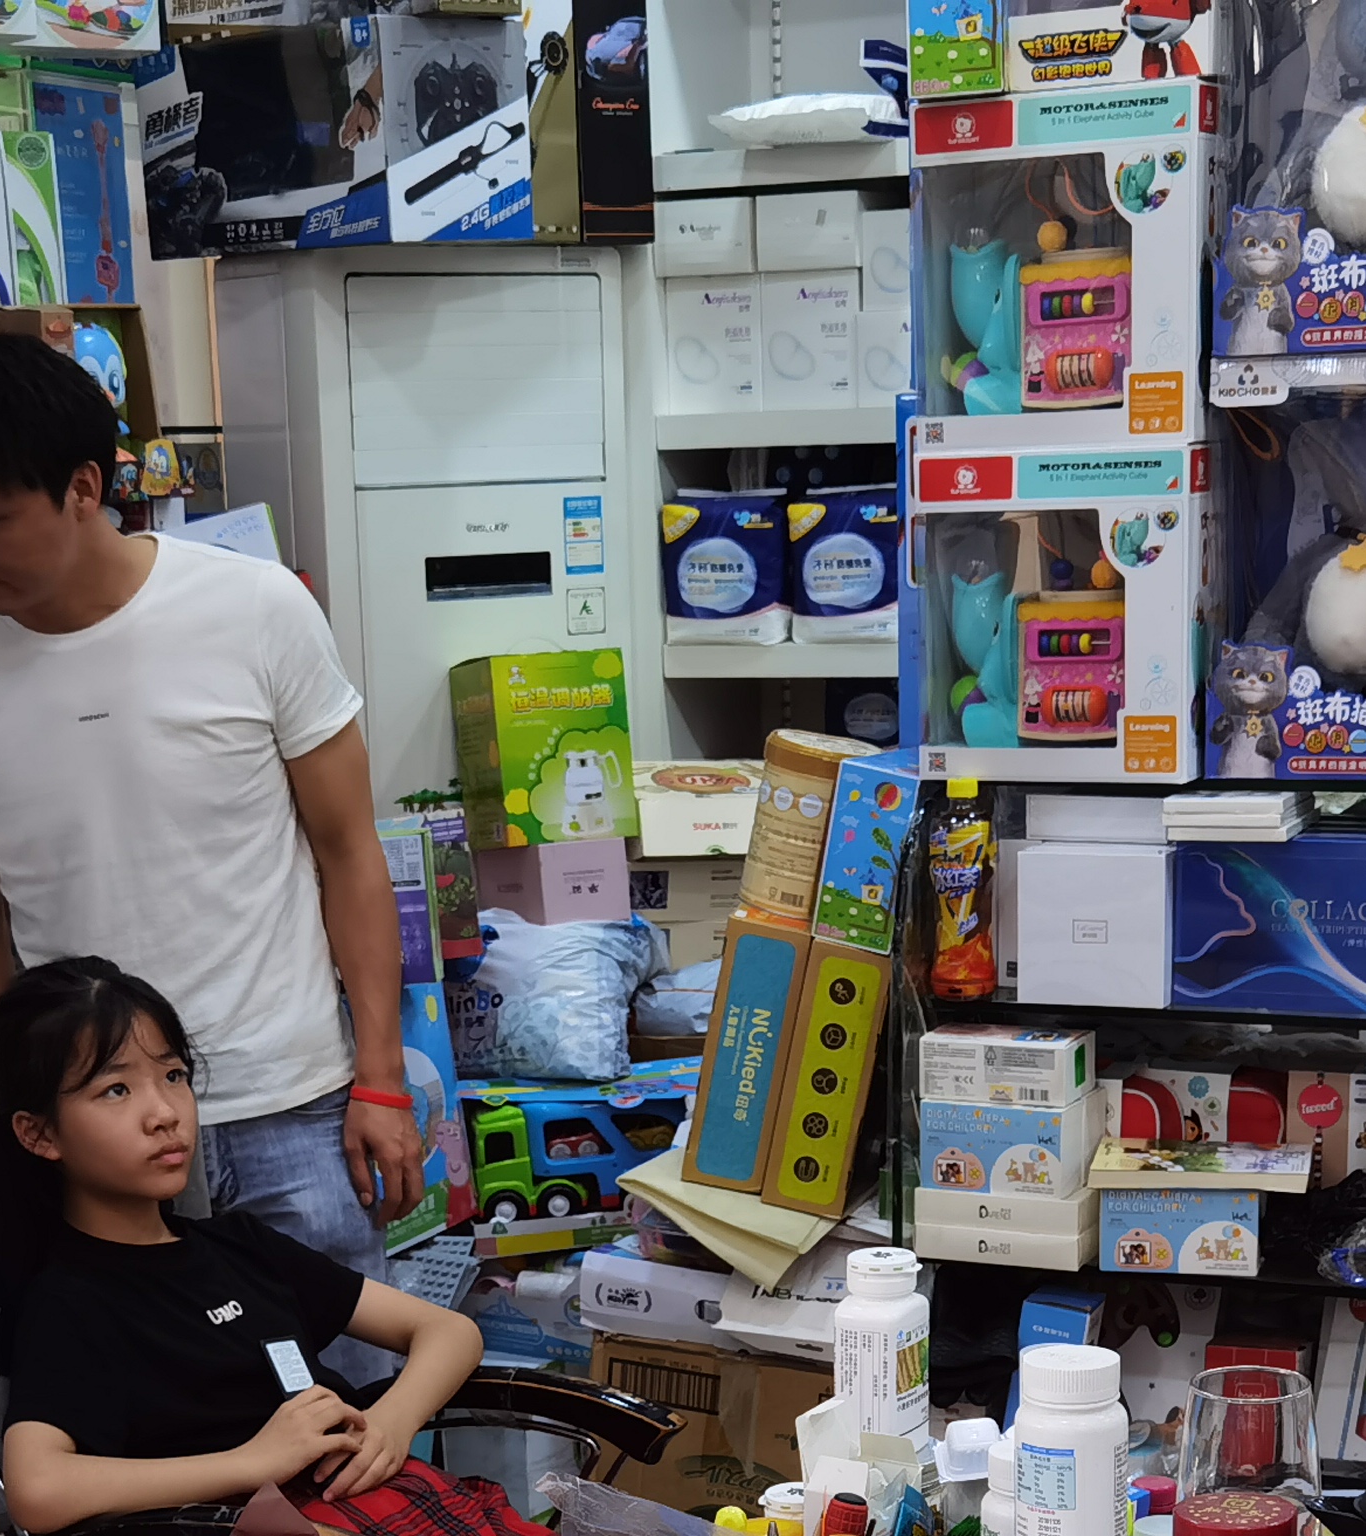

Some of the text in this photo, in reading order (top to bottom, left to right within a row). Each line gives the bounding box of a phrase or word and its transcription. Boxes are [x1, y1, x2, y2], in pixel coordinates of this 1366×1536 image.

[1033, 31, 1110, 58] 超级飞侠
[1039, 96, 1170, 116] MOTOR&SENSES
[460, 204, 491, 230] 2.4G
[1038, 459, 1163, 473] MOTOR&SENSES
[509, 683, 614, 714] 恒温调奶器
[926, 1108, 963, 1121] DIGITAL
